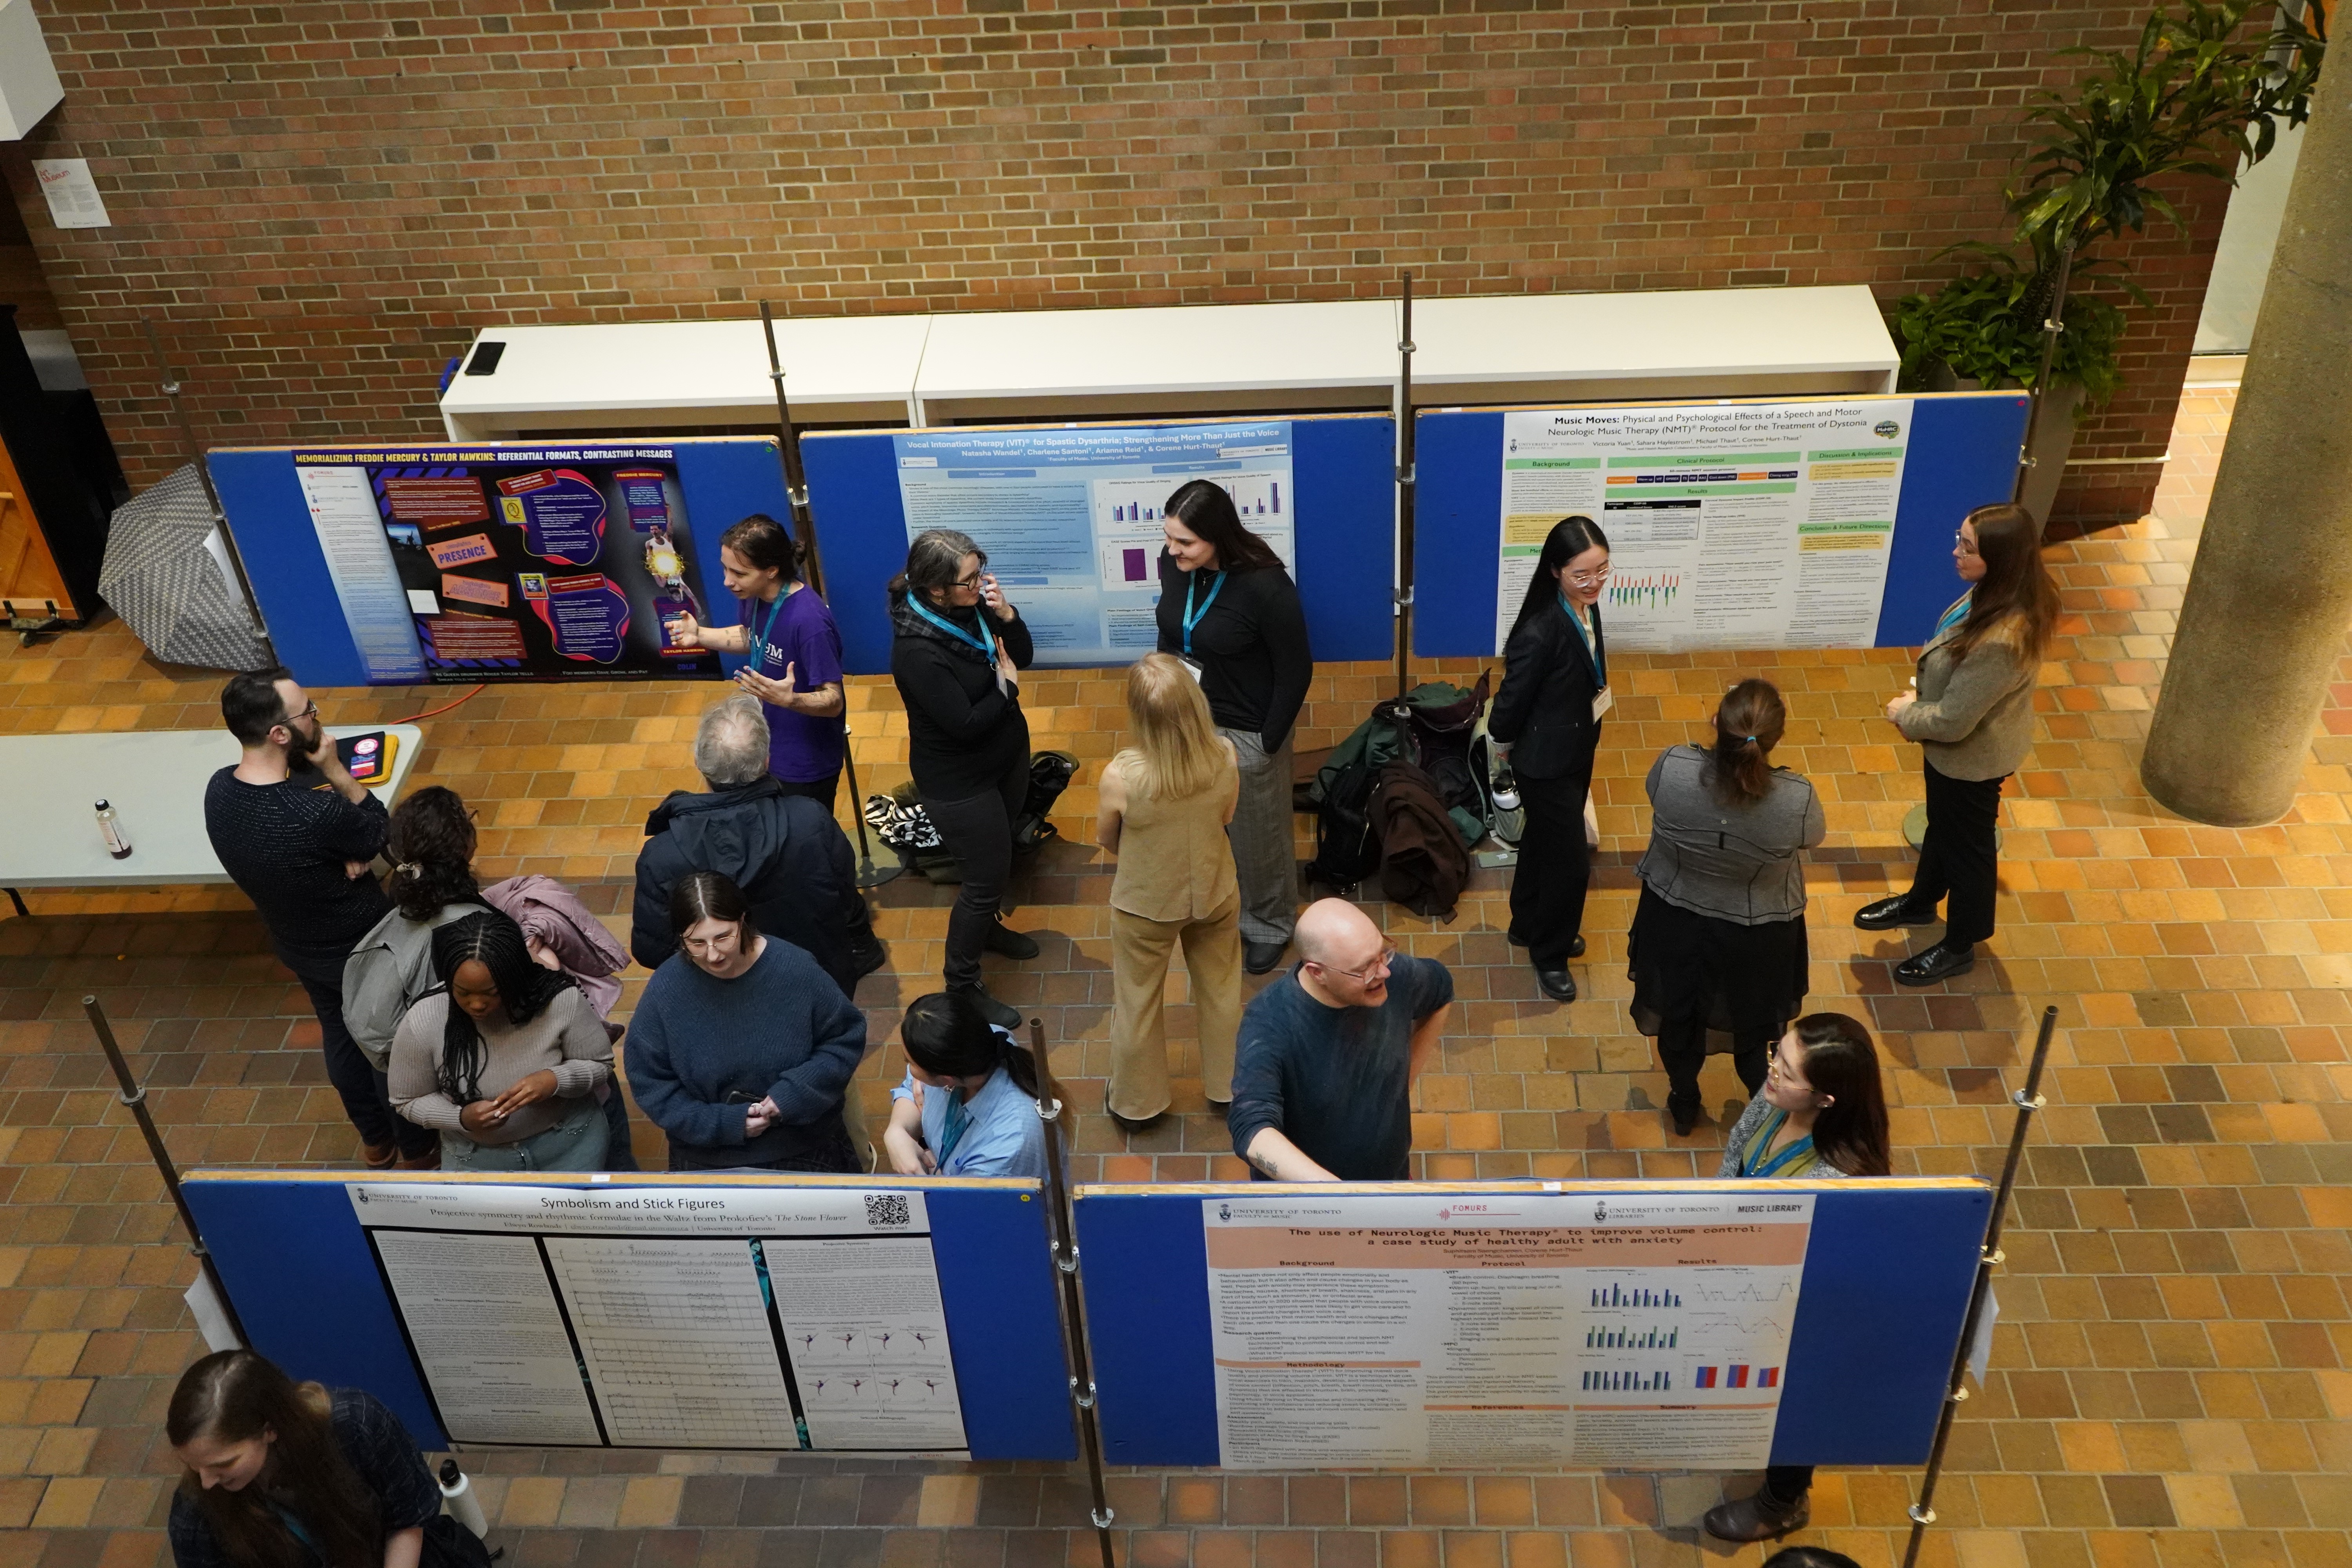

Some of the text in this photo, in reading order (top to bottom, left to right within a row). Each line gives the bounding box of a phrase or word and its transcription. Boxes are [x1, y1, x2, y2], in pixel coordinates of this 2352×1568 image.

[1623, 416, 1655, 424] Physical
[1676, 412, 1731, 423] Psychological
[1784, 410, 1813, 419] Speech
[1548, 428, 1594, 437] Neurologic
[1625, 426, 1659, 436] Therapy
[1830, 420, 1867, 429] Dystonia
[1047, 438, 1076, 446] Spastic
[1078, 436, 1121, 445] Dysarthria;
[1123, 434, 1179, 444] Strengthening
[296, 454, 353, 463] MEMORIALIZING
[386, 454, 420, 462] MERCURY
[422, 453, 429, 462] &
[430, 453, 457, 461] TAYLOR
[459, 452, 495, 461] HAWKINS:
[498, 452, 543, 460] REFERENTIAL
[546, 451, 581, 460] FORMATS,
[583, 450, 634, 459] CONTRASTING
[636, 450, 673, 458] MESSAGES
[438, 545, 486, 563] PRESENCE
[542, 1198, 724, 1210] Symbolism and Stick Figures
